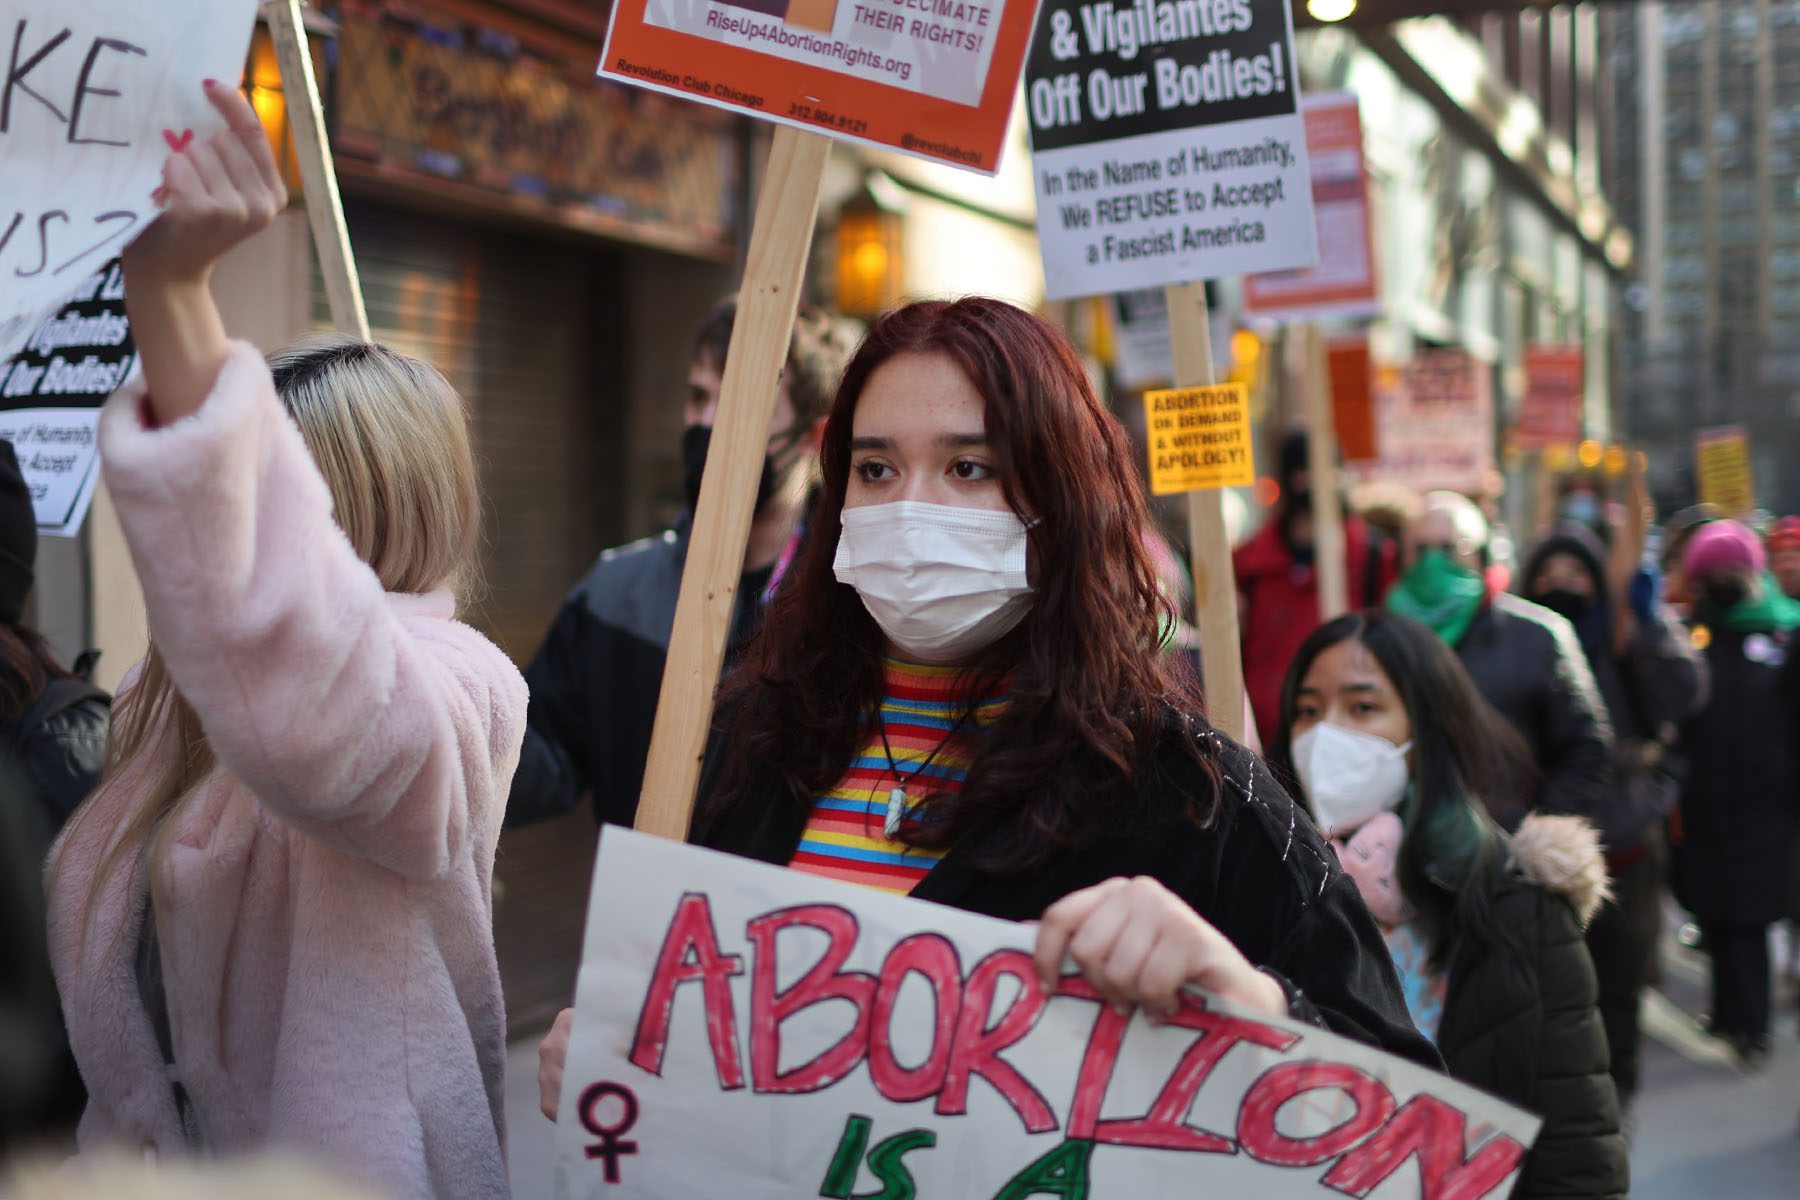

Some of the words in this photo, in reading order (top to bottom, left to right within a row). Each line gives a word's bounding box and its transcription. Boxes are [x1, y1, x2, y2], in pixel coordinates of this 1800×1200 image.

[854, 5, 905, 33] THEIR
[910, 20, 983, 53] RIGHTS!
[893, 0, 991, 27] ECIMATE
[1051, 9, 1080, 60] &
[1080, 0, 1253, 59] Vigilantes
[706, 10, 912, 80] RiseUp4AbortionRights.org
[616, 58, 680, 85] Revolution
[683, 75, 711, 93] Club
[714, 83, 764, 107] Chicago
[1031, 73, 1082, 129] Off
[1087, 68, 1148, 121] Our
[1154, 41, 1286, 110] Bodies!
[1042, 170, 1062, 195] In
[1067, 165, 1098, 192] the
[1102, 158, 1162, 186] Name
[1167, 150, 1187, 176] of
[1192, 137, 1296, 173] Humanity,
[1060, 203, 1091, 230] We
[1096, 188, 1180, 225] REFUSE
[1183, 188, 1206, 212] to
[1212, 176, 1285, 209] Accept
[1086, 244, 1099, 265] a
[1104, 229, 1175, 261] Fascist
[1181, 218, 1266, 249] America
[1153, 390, 1239, 413] ABORTION
[1177, 411, 1242, 428] DEMAND
[1157, 447, 1246, 470] APOLOGY!
[1172, 429, 1241, 448] WITHOUT
[629, 891, 1525, 1200] ABORTION
[819, 1113, 937, 1200] IS
